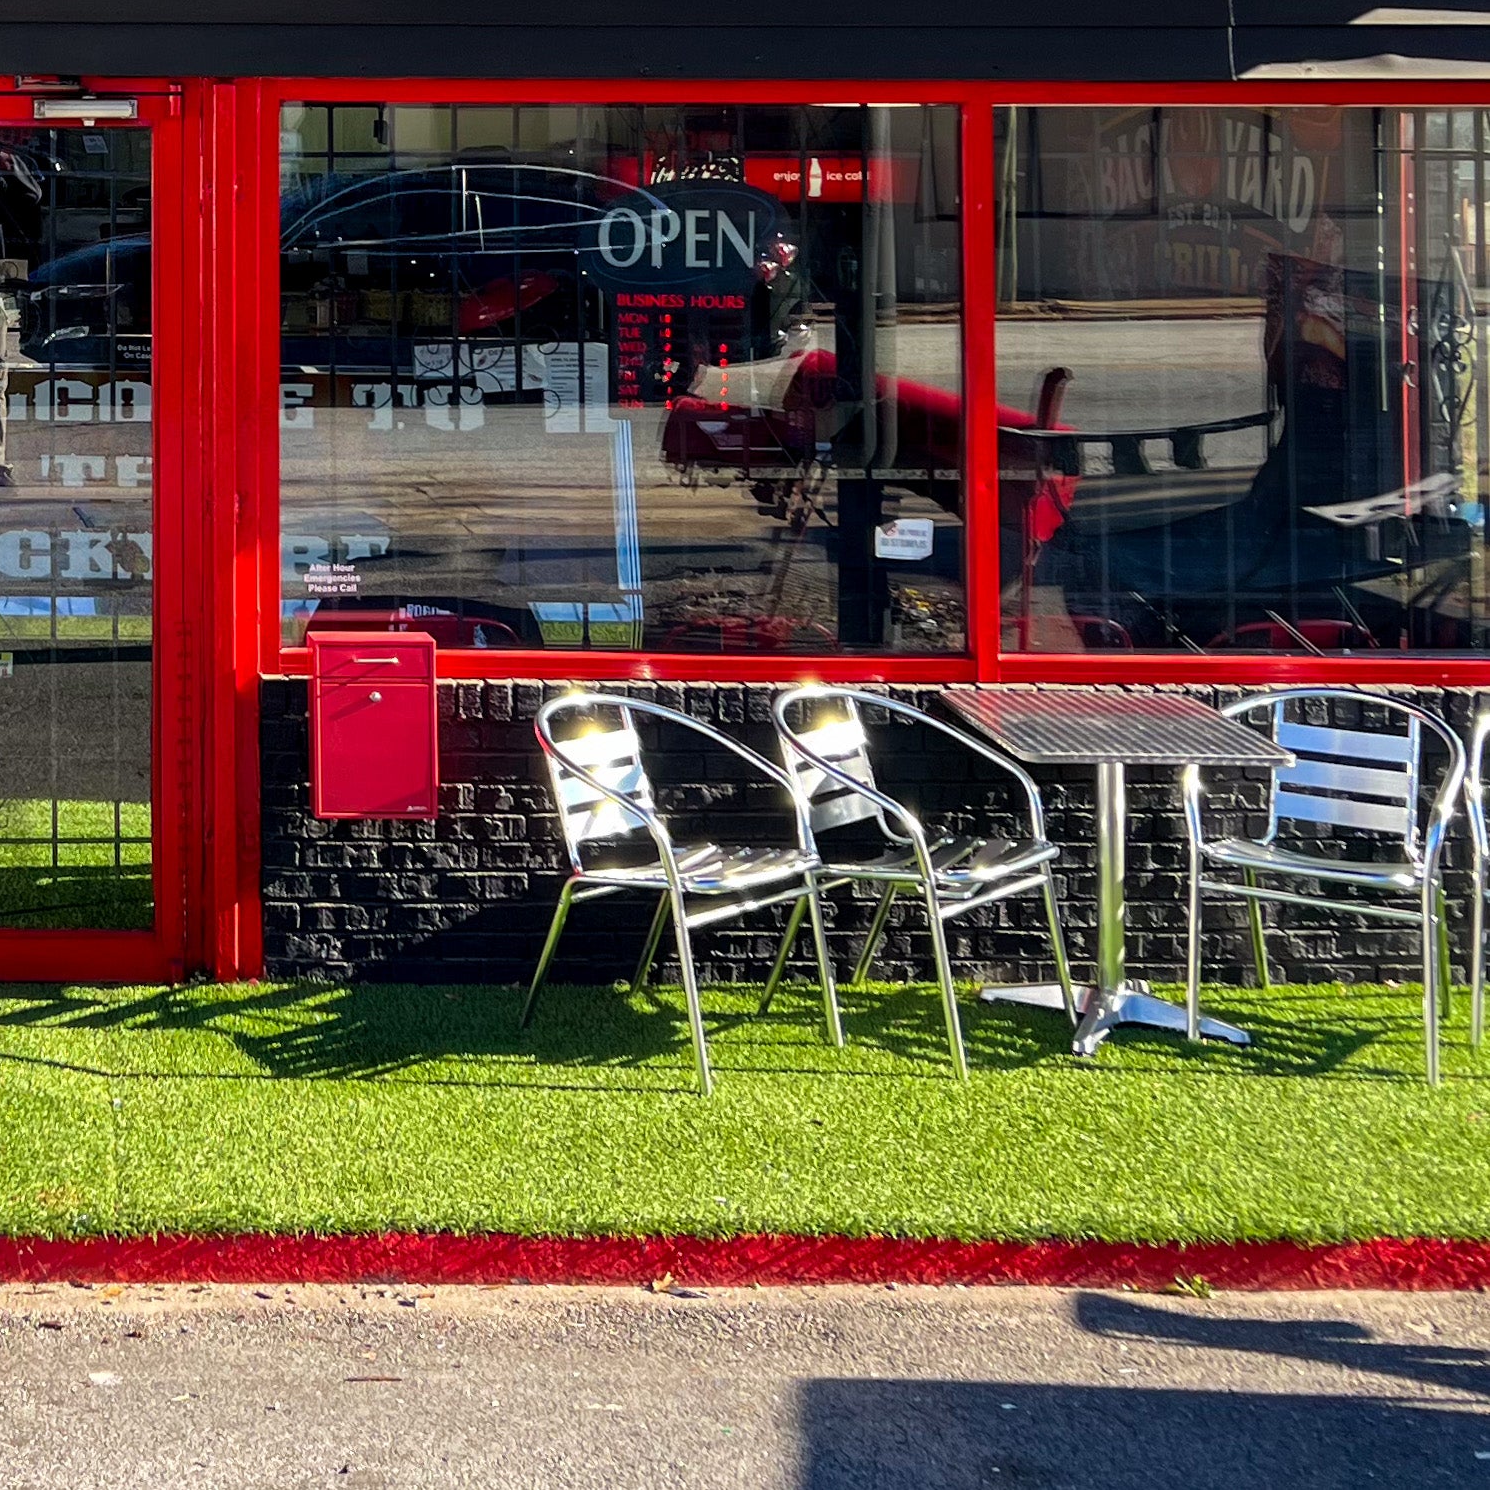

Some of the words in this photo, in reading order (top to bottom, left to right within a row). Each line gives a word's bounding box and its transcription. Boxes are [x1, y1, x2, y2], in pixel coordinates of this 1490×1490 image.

[826, 171, 843, 181] ice
[598, 208, 756, 270] OPEN
[617, 293, 685, 307] BUSINESS
[690, 295, 745, 309] HOURS
[618, 312, 649, 324] MON
[618, 327, 640, 338] TUE
[309, 563, 331, 572] After
[332, 563, 356, 572] Hour
[303, 573, 361, 584] Emergencies
[308, 584, 338, 592] Please
[339, 584, 358, 592] Call
